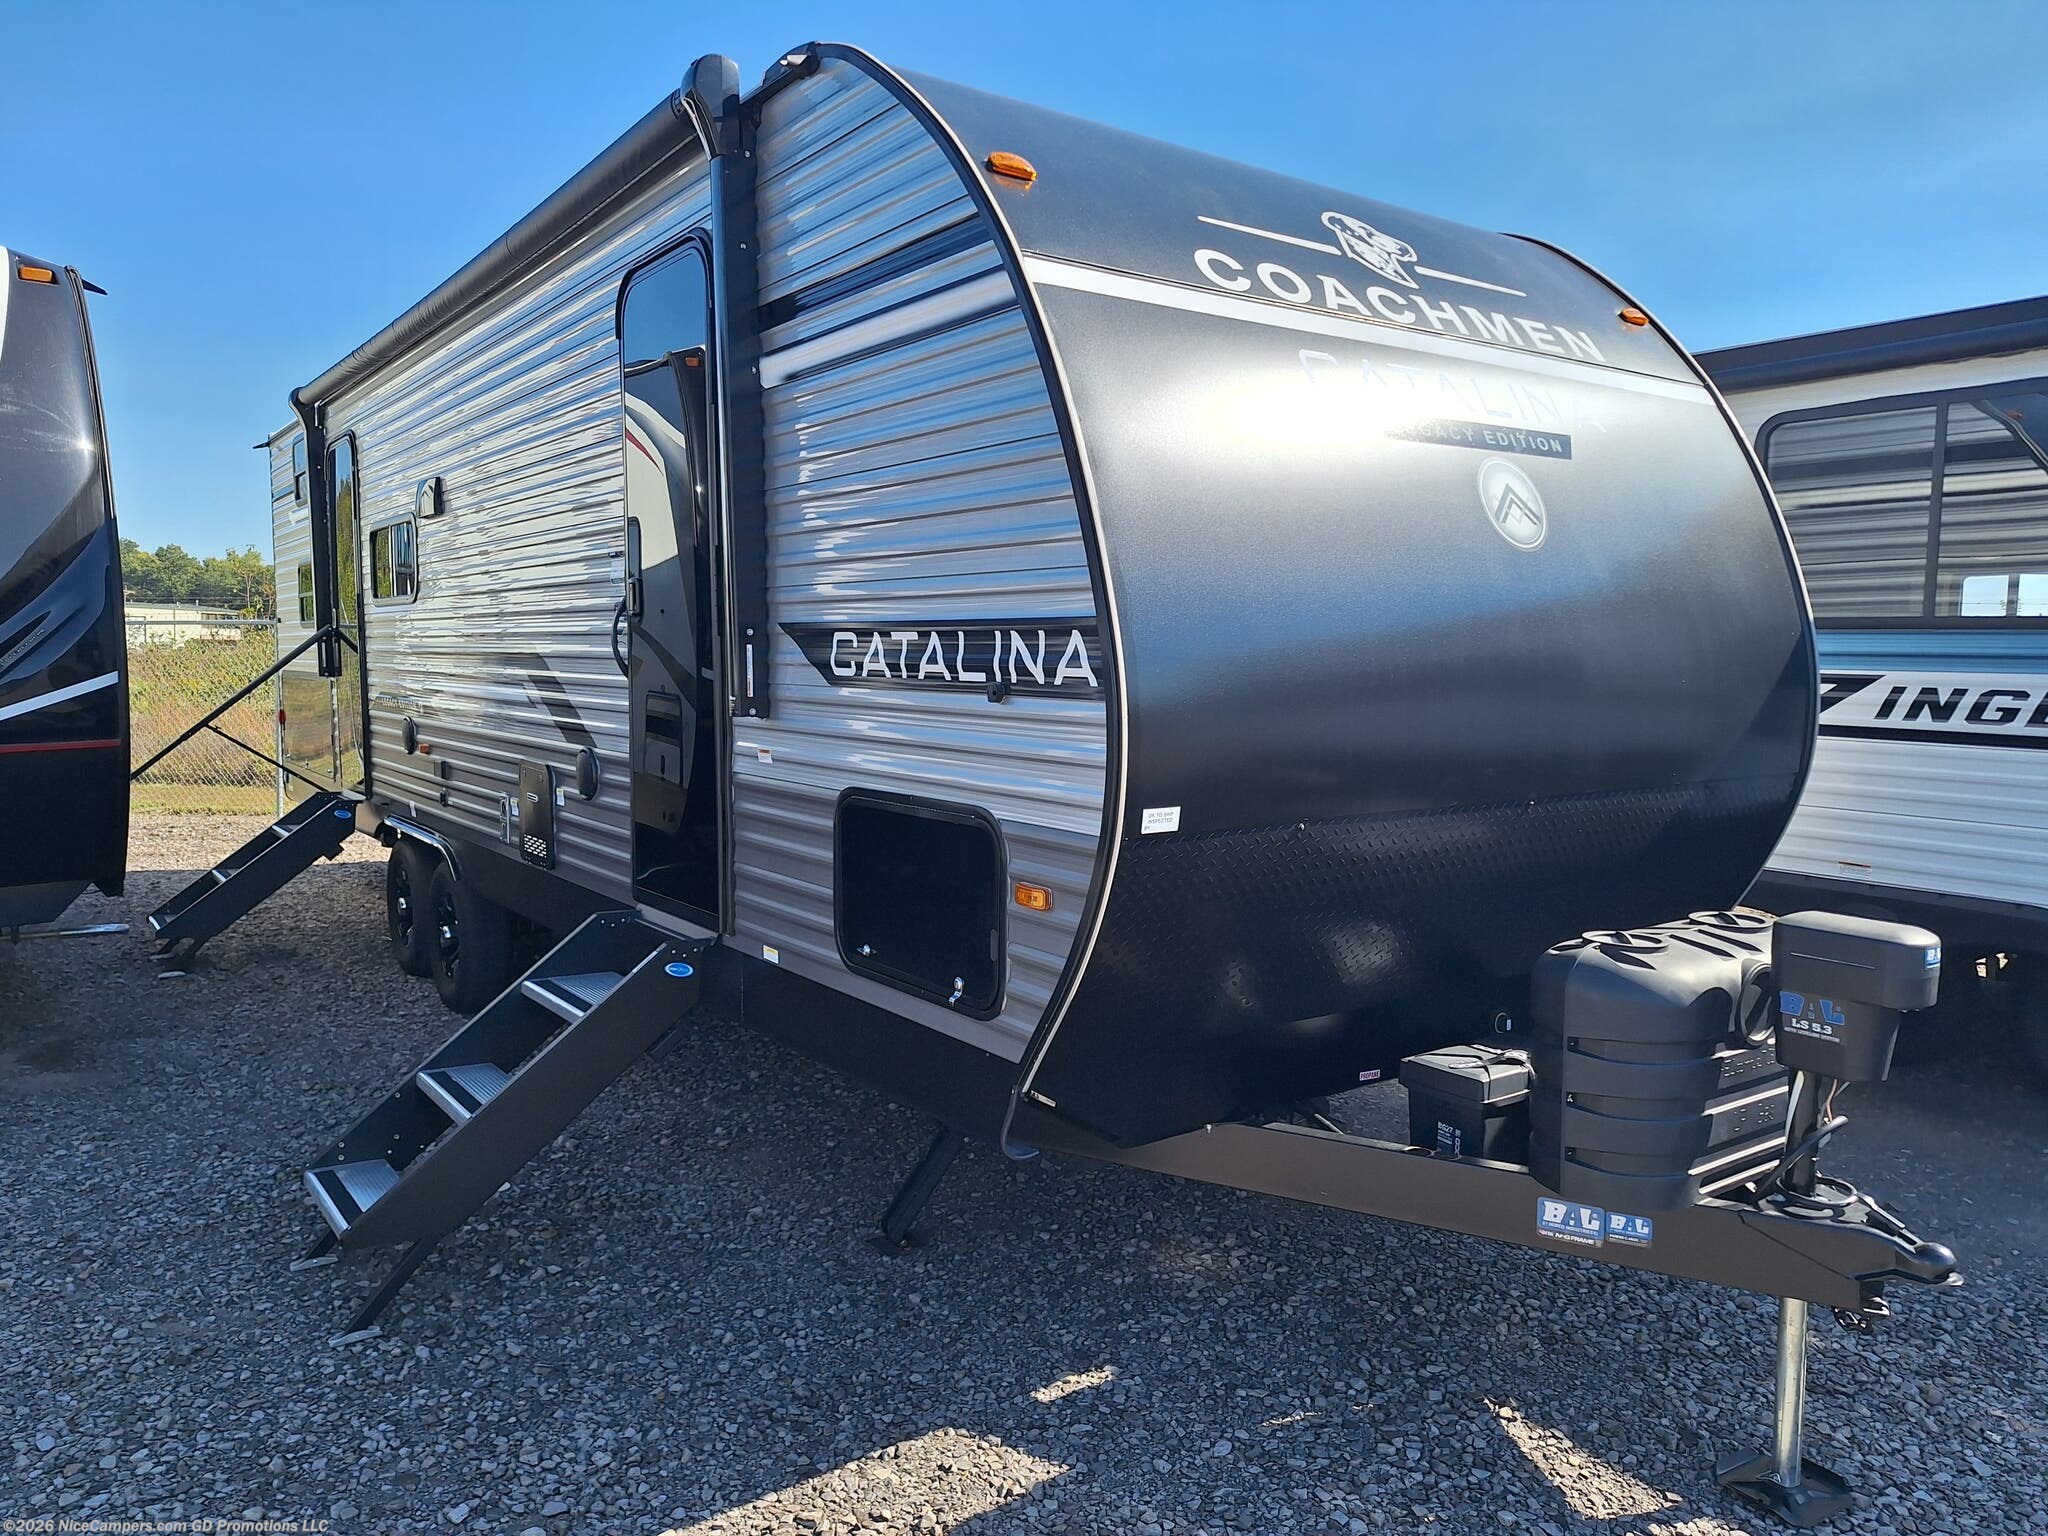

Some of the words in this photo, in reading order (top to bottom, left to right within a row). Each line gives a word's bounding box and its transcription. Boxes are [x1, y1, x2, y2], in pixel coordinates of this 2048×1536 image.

[1193, 248, 1607, 362] COACHMEN
[1483, 430, 1562, 453] EDITION
[830, 629, 1099, 688] CATALINA
[1780, 991, 1846, 1026] BAL
[1792, 1018, 1809, 1029] LS
[1543, 1200, 1601, 1231] BAL
[1610, 1214, 1650, 1235] BAL
